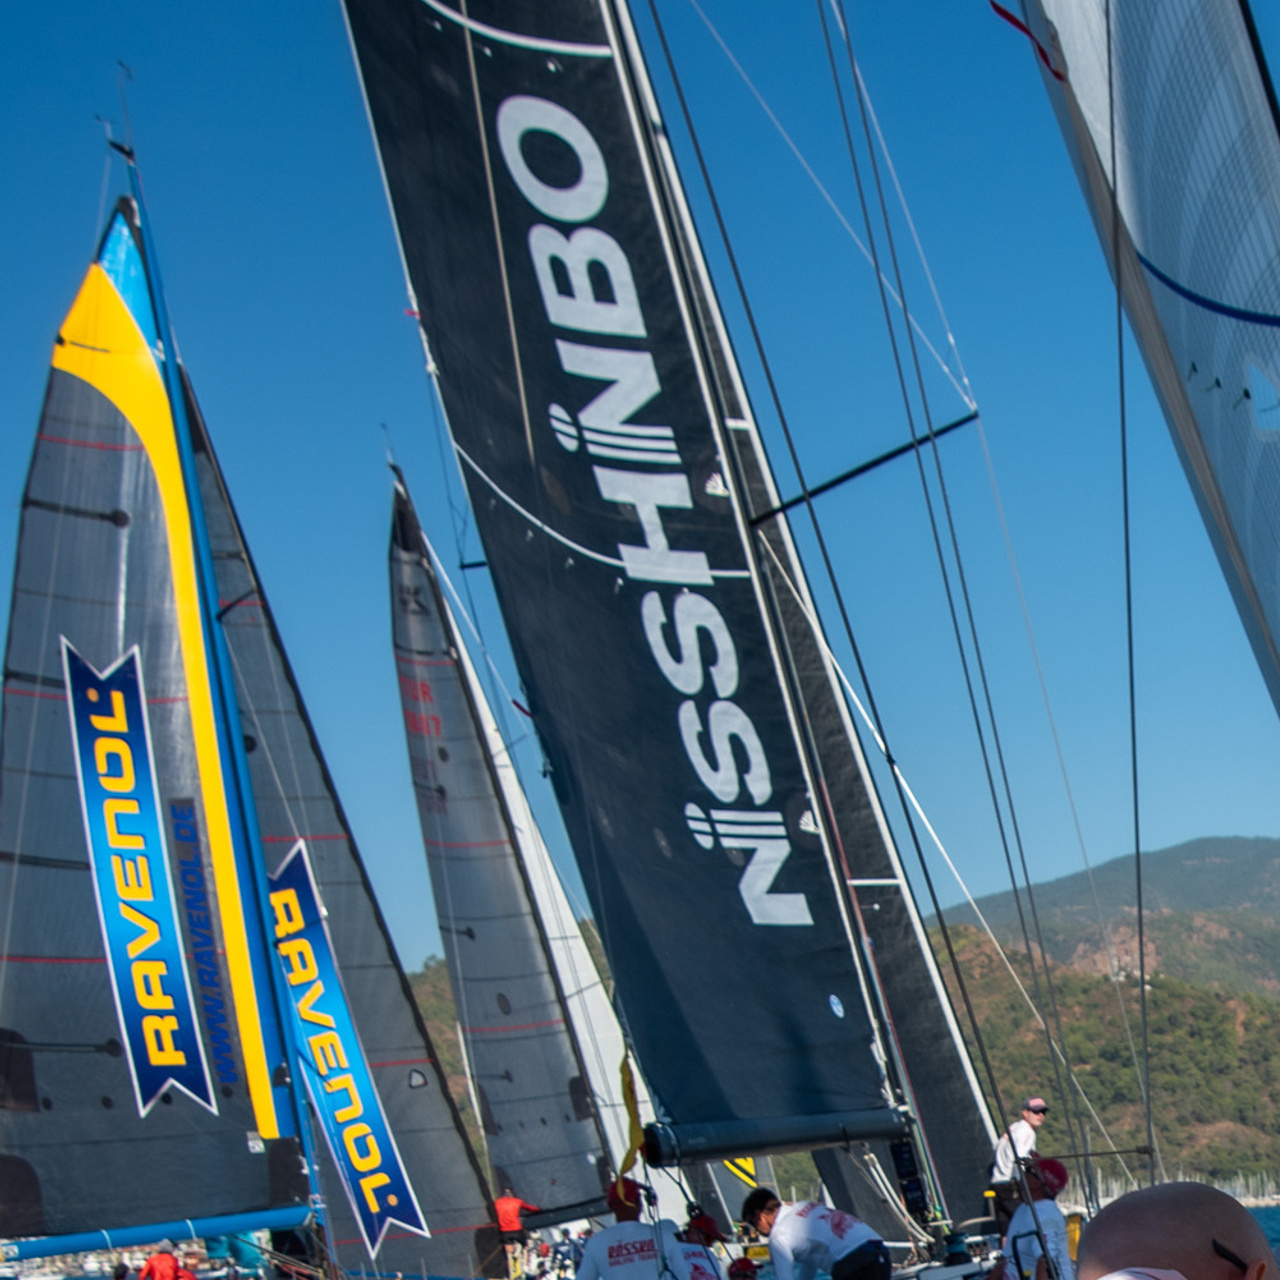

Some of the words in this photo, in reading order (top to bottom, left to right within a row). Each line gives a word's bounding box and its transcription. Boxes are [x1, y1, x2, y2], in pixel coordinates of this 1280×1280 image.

[87, 687, 187, 1068] RAVENOL
[170, 804, 239, 1085] WWW.RAVENOL.DE
[270, 887, 396, 1214] RAVENOL
